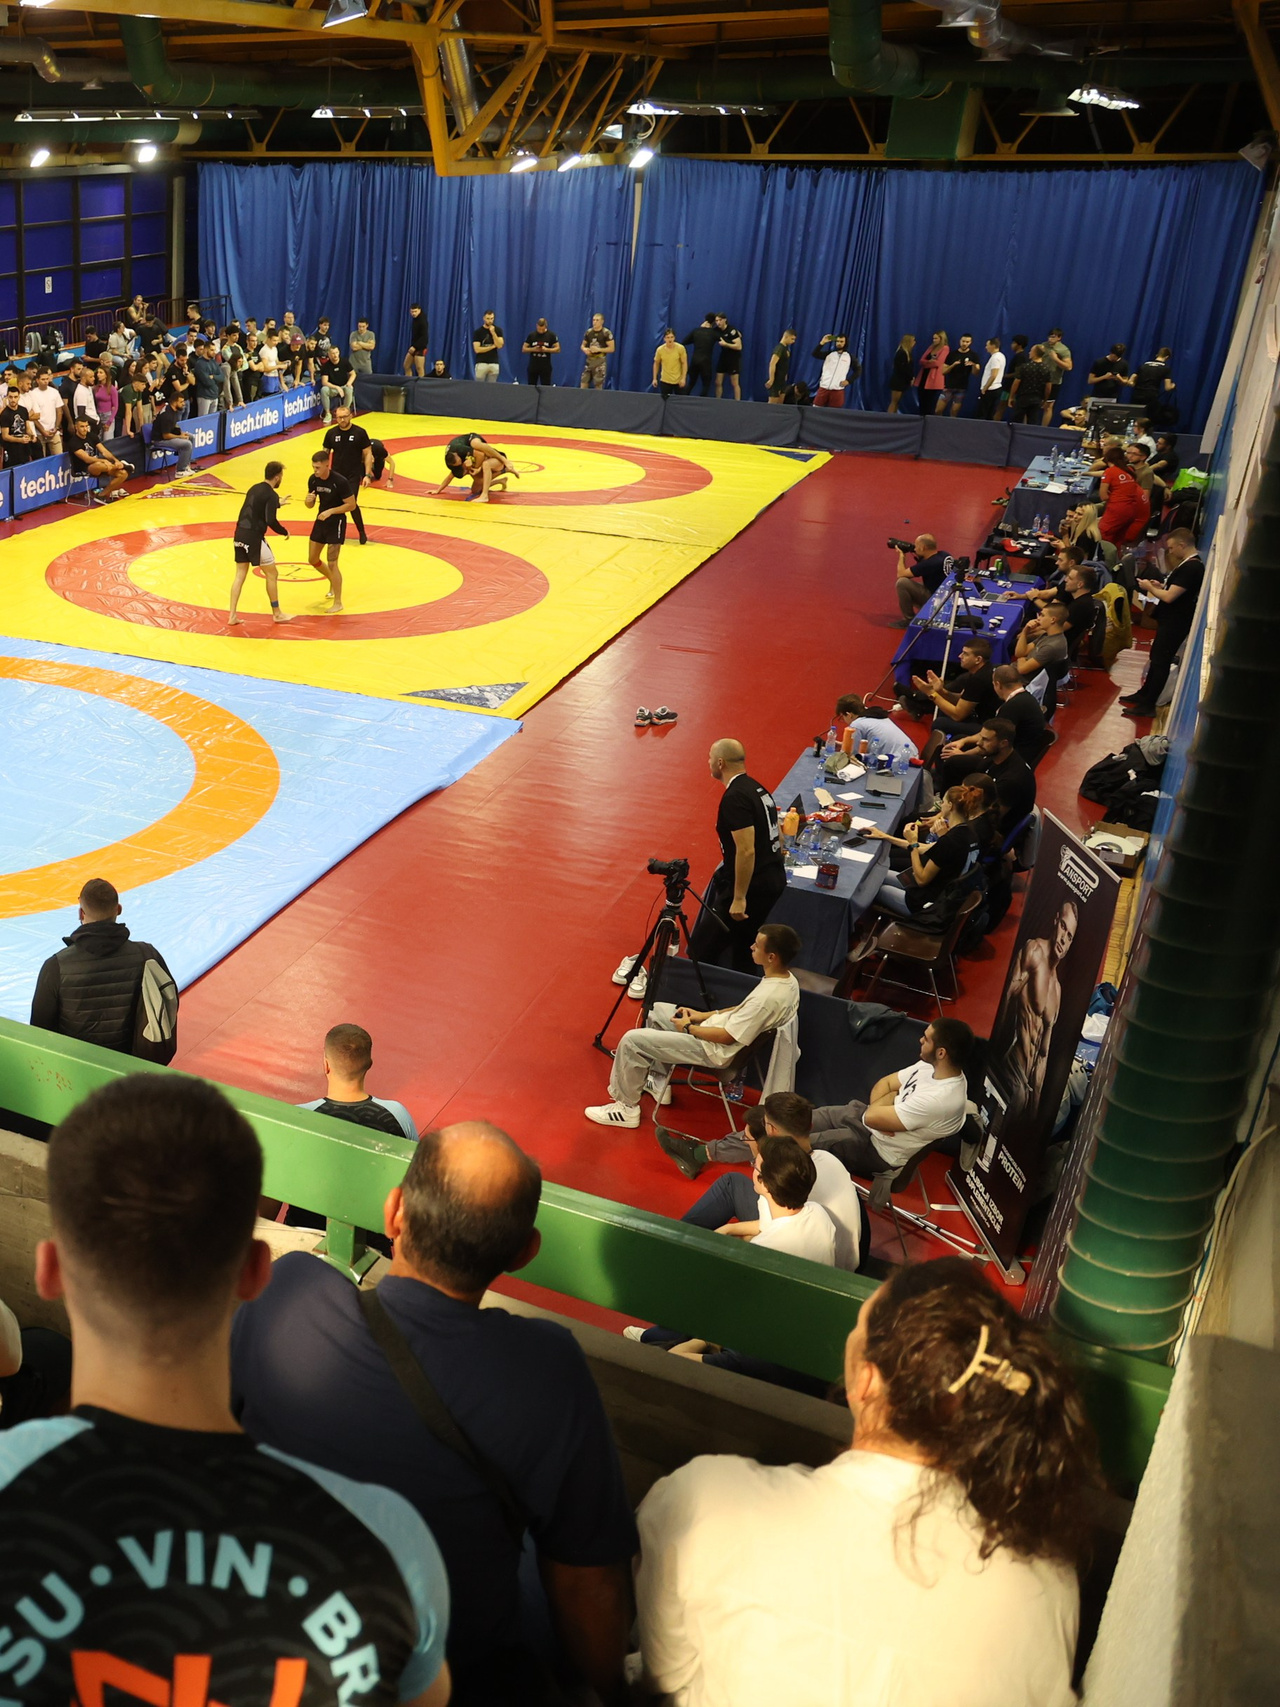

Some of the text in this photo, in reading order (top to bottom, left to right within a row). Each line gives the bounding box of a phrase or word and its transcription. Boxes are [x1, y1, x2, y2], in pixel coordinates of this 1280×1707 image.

[284, 390, 321, 418] tech.tribe
[230, 408, 279, 438] tech.tribe
[997, 1150, 1025, 1194] PROTEIN
[965, 1174, 1002, 1235] SUPLEMENTACIJE
[988, 1198, 1005, 1226] IZBOR
[117, 1529, 273, 1597] VIN
